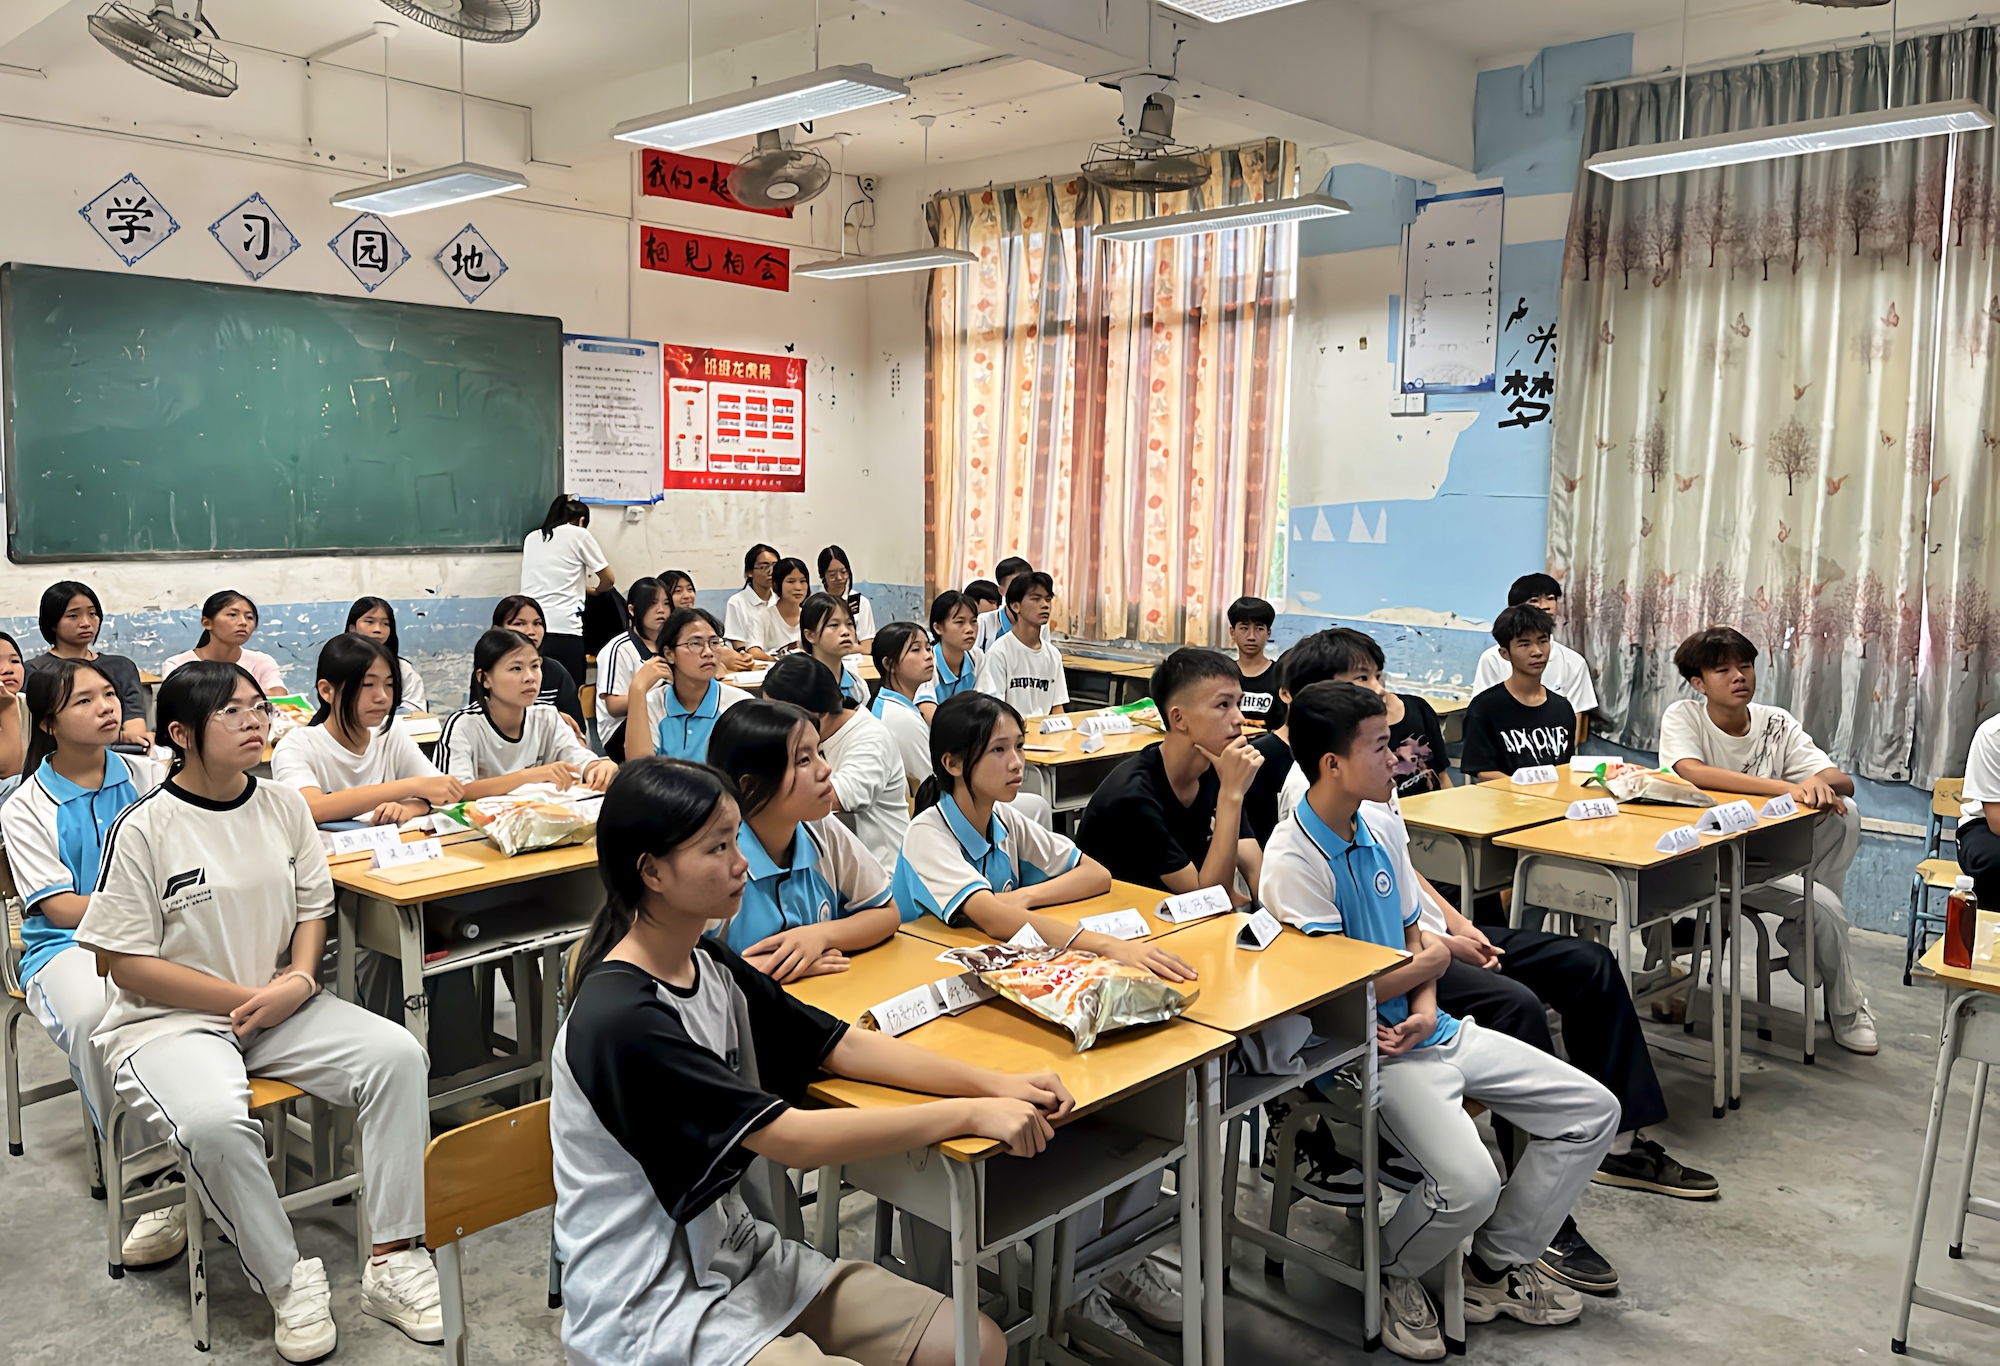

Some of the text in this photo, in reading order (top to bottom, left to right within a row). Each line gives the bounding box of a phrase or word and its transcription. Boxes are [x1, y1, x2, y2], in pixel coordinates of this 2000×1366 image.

[704, 357, 771, 380] 班级龙虎榜
[1243, 696, 1271, 708] HERO
